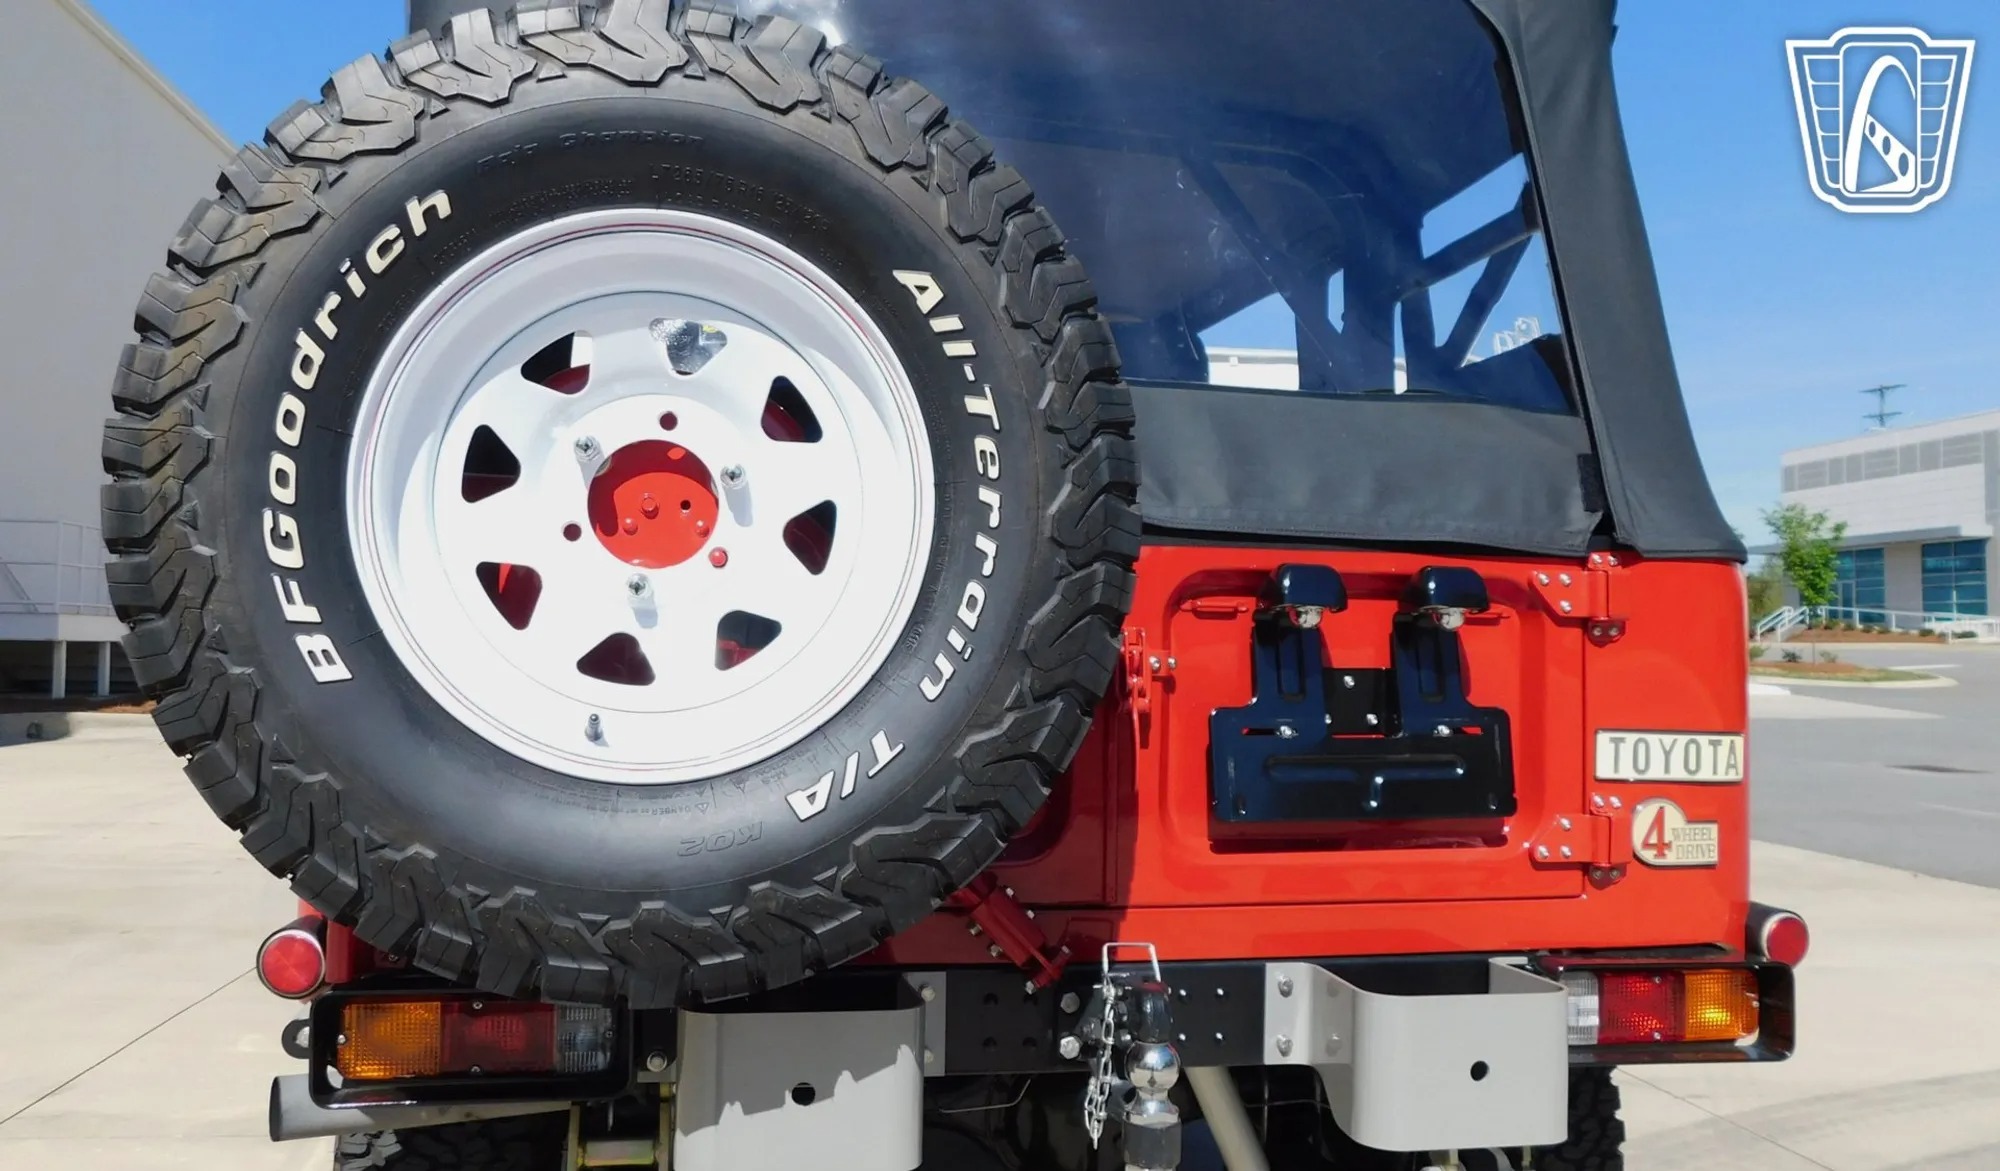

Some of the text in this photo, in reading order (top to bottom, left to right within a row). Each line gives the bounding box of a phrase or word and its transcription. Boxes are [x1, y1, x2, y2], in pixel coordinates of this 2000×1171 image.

[262, 189, 453, 684] BFGoodrich
[677, 269, 1001, 857] All-Terrain T/A KO2
[1609, 737, 1740, 776] TOYOTA
[1641, 805, 1673, 860] 4
[1671, 826, 1715, 841] WHEEL
[1675, 843, 1716, 860] DRIVE
